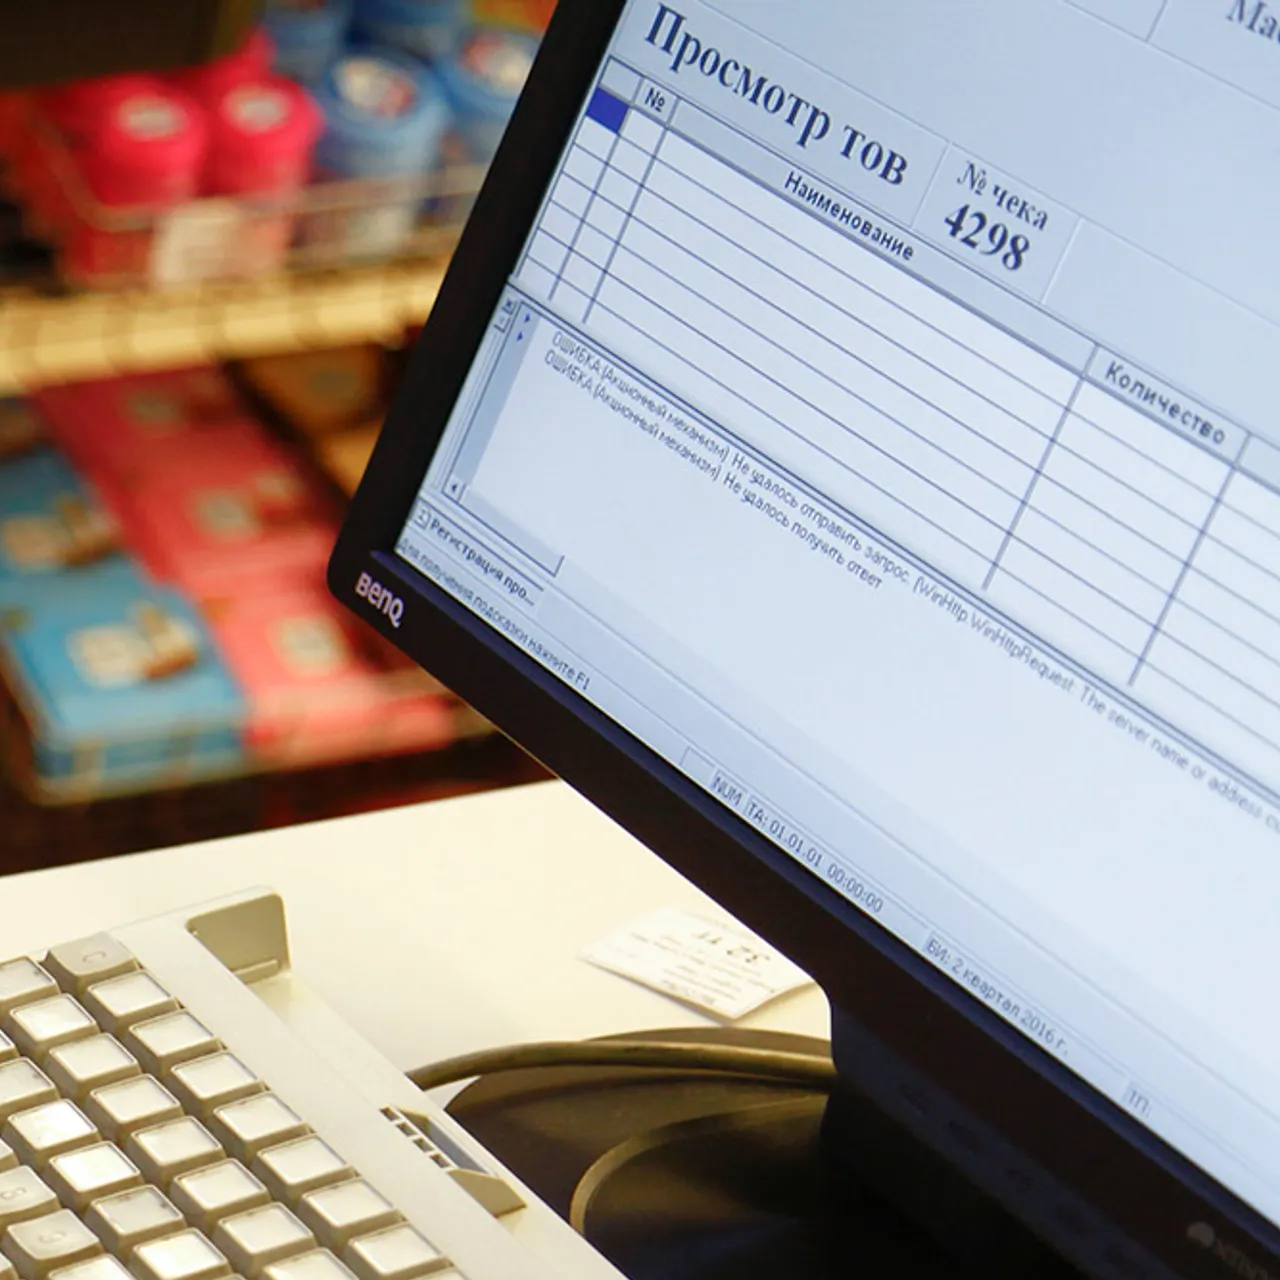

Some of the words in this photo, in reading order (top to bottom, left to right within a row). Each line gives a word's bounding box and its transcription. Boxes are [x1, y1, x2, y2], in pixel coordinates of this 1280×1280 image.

[644, 3, 831, 149] Просмотр
[839, 125, 908, 186] тов
[645, 87, 666, 113] №
[784, 171, 914, 261] Наименование
[945, 203, 1030, 271] 4298
[957, 160, 988, 197] №
[992, 184, 1049, 231] чека
[1105, 360, 1226, 445] Количество
[429, 518, 504, 582] Регистрация
[723, 472, 741, 495] Не
[742, 487, 790, 529] удалось
[790, 521, 846, 567] получить
[846, 558, 883, 591] ответ
[471, 596, 529, 645] подсказки
[731, 451, 750, 477] Не
[751, 468, 798, 509] удалось
[799, 500, 862, 552] отправить
[1080, 685, 1107, 715] The
[1107, 708, 1150, 743] server
[1150, 737, 1190, 771] name
[1207, 775, 1263, 820] address
[712, 776, 742, 807] NUM
[769, 818, 823, 869] 01.01.01
[827, 863, 884, 914] 00:00:00
[951, 957, 964, 974] 2
[963, 970, 1020, 1018] квартал
[1020, 1010, 1055, 1044] 2016
